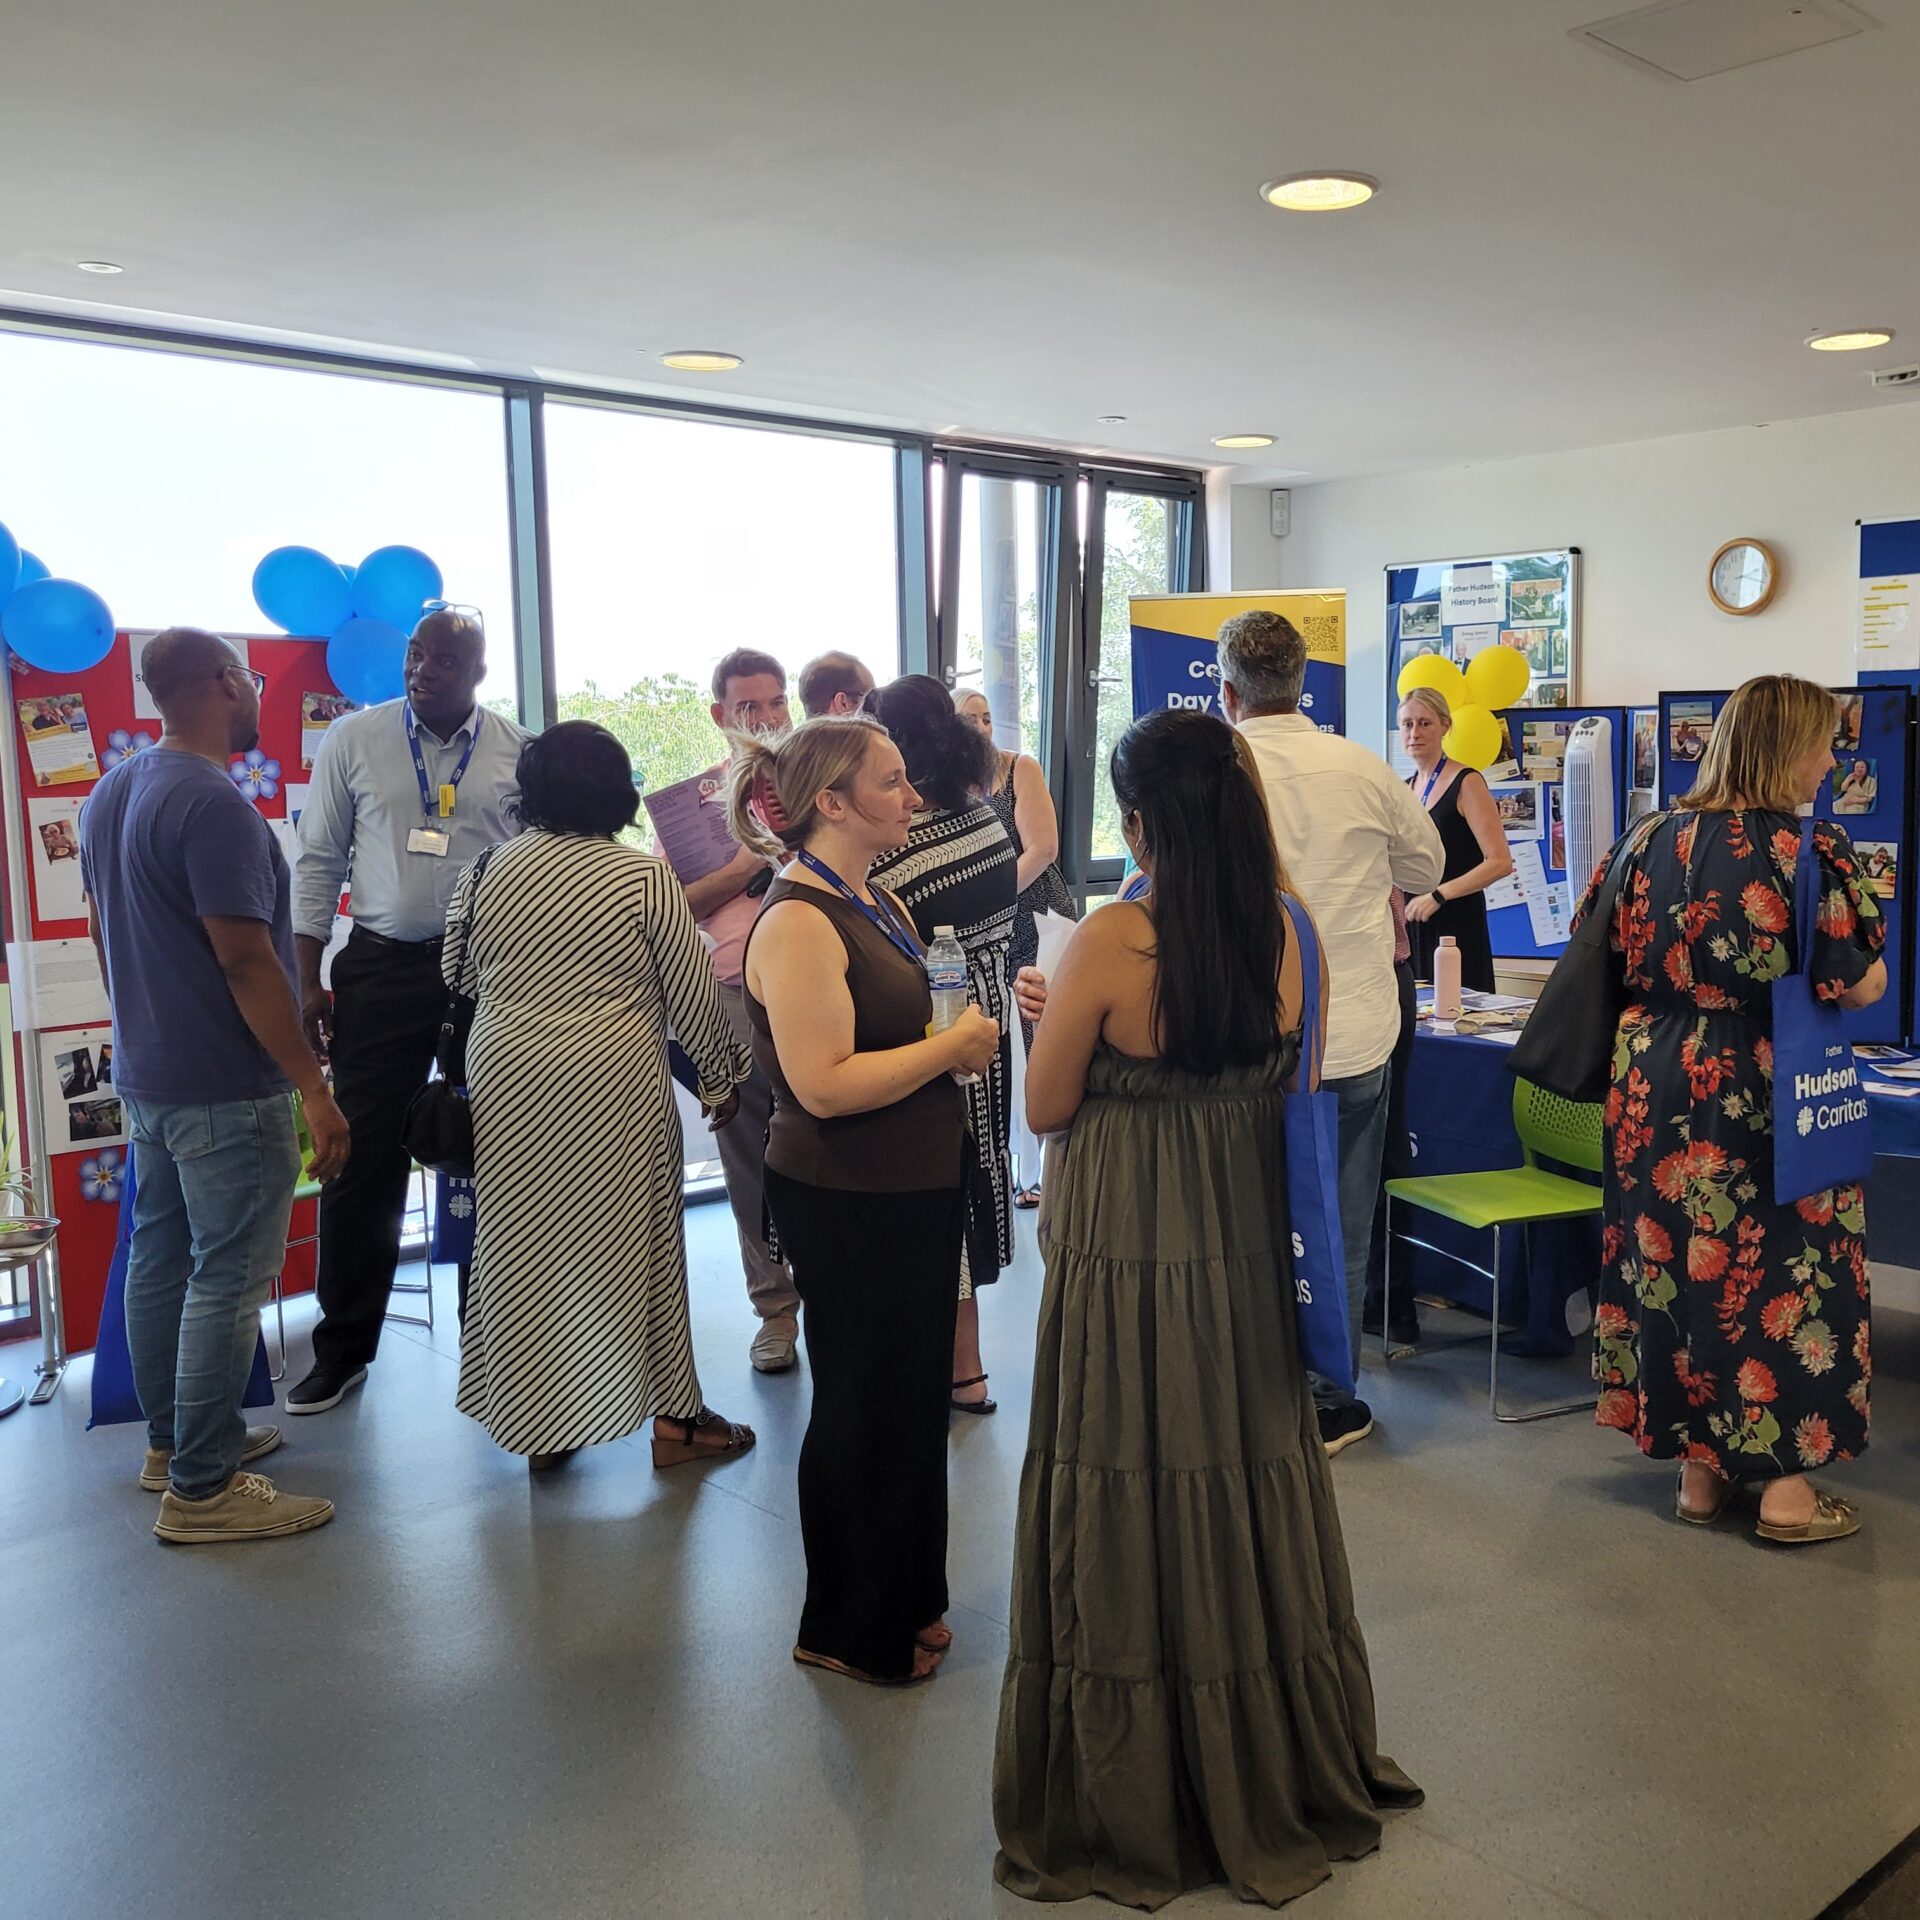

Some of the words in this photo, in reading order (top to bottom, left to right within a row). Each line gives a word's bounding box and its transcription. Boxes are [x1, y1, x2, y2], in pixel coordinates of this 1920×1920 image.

[1451, 598, 1477, 606] History
[1478, 596, 1498, 605] Board
[1167, 692, 1213, 714] Day
[1794, 1067, 1857, 1100] Hudson
[1816, 1097, 1868, 1129] Caritas
